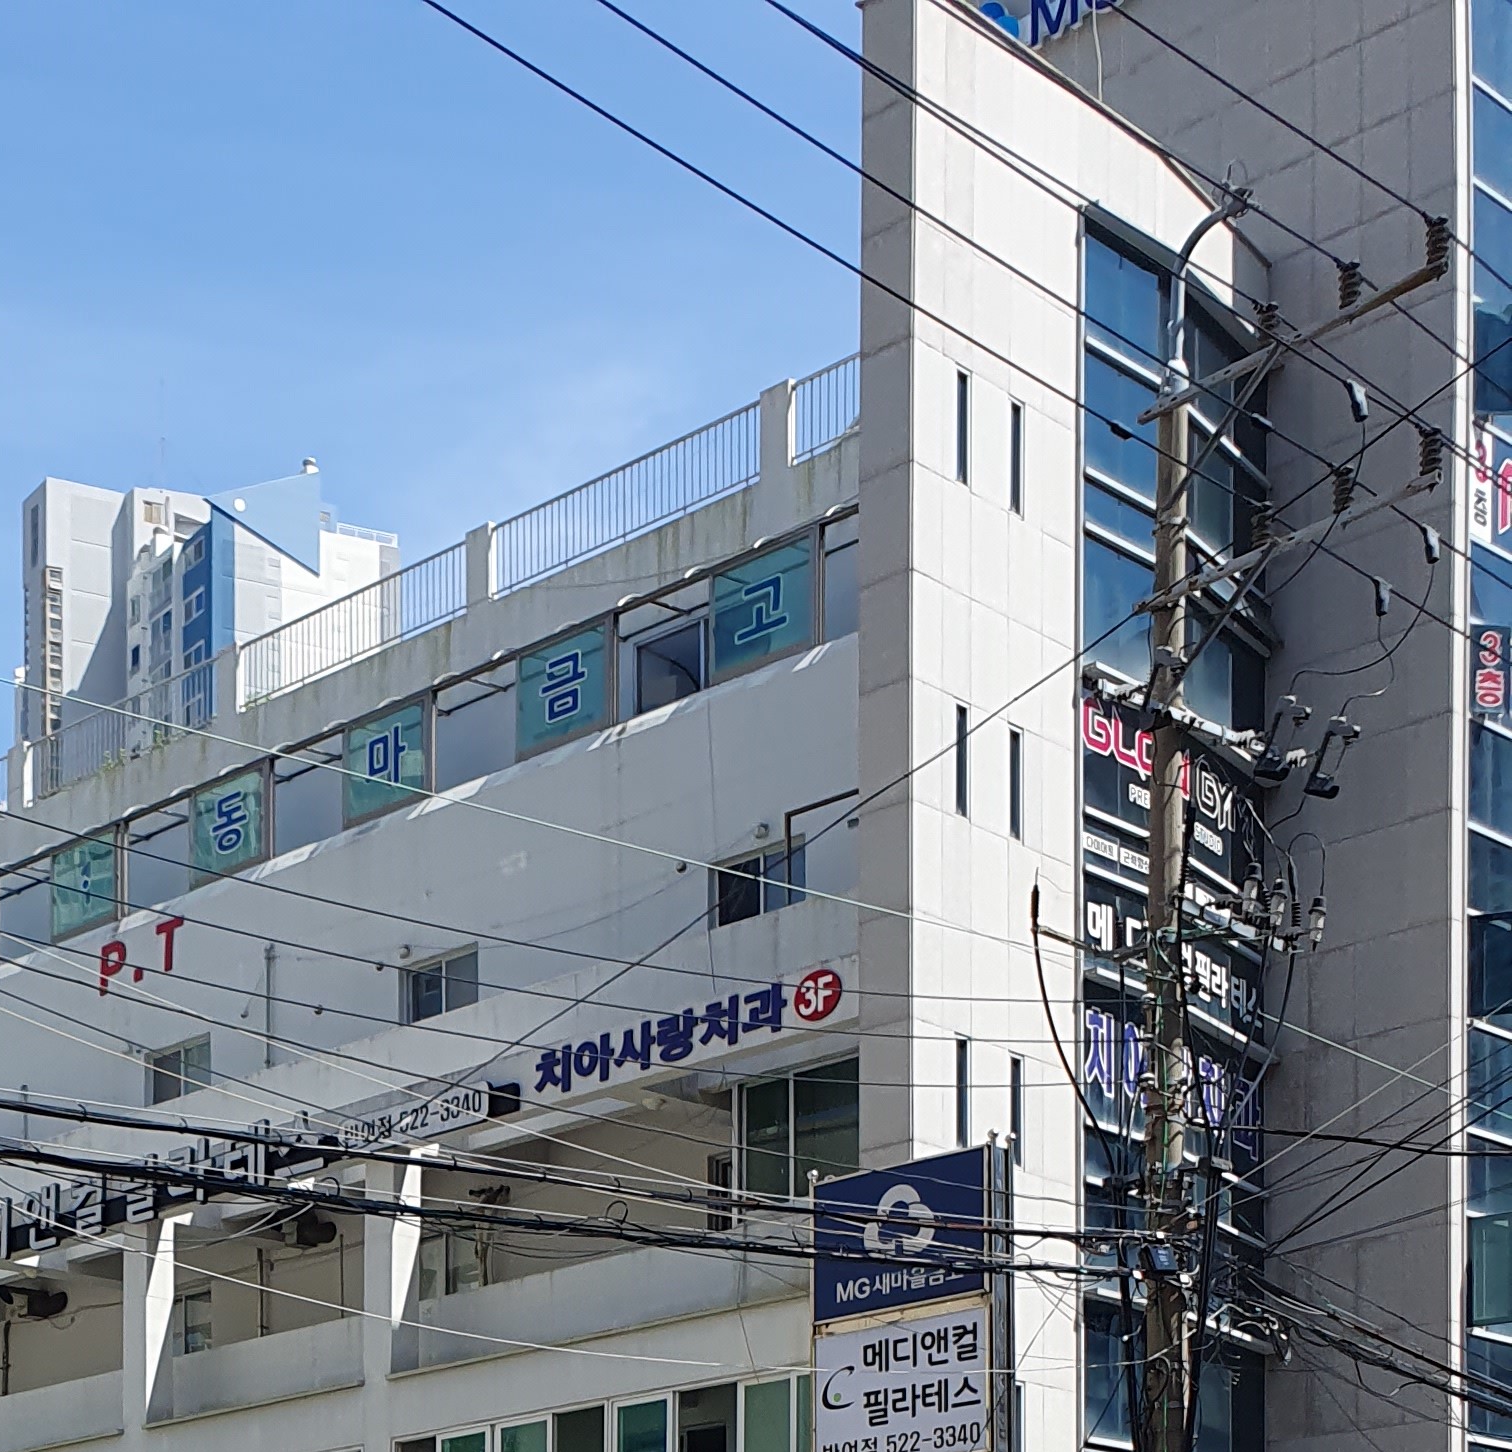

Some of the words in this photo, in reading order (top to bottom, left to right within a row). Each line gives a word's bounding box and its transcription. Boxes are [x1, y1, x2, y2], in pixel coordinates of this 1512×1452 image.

[534, 983, 788, 1093] 치아사랑치과
[798, 975, 837, 1017] 3F
[862, 1322, 979, 1373] 메디앤컬
[863, 1376, 982, 1428] 필라테스
